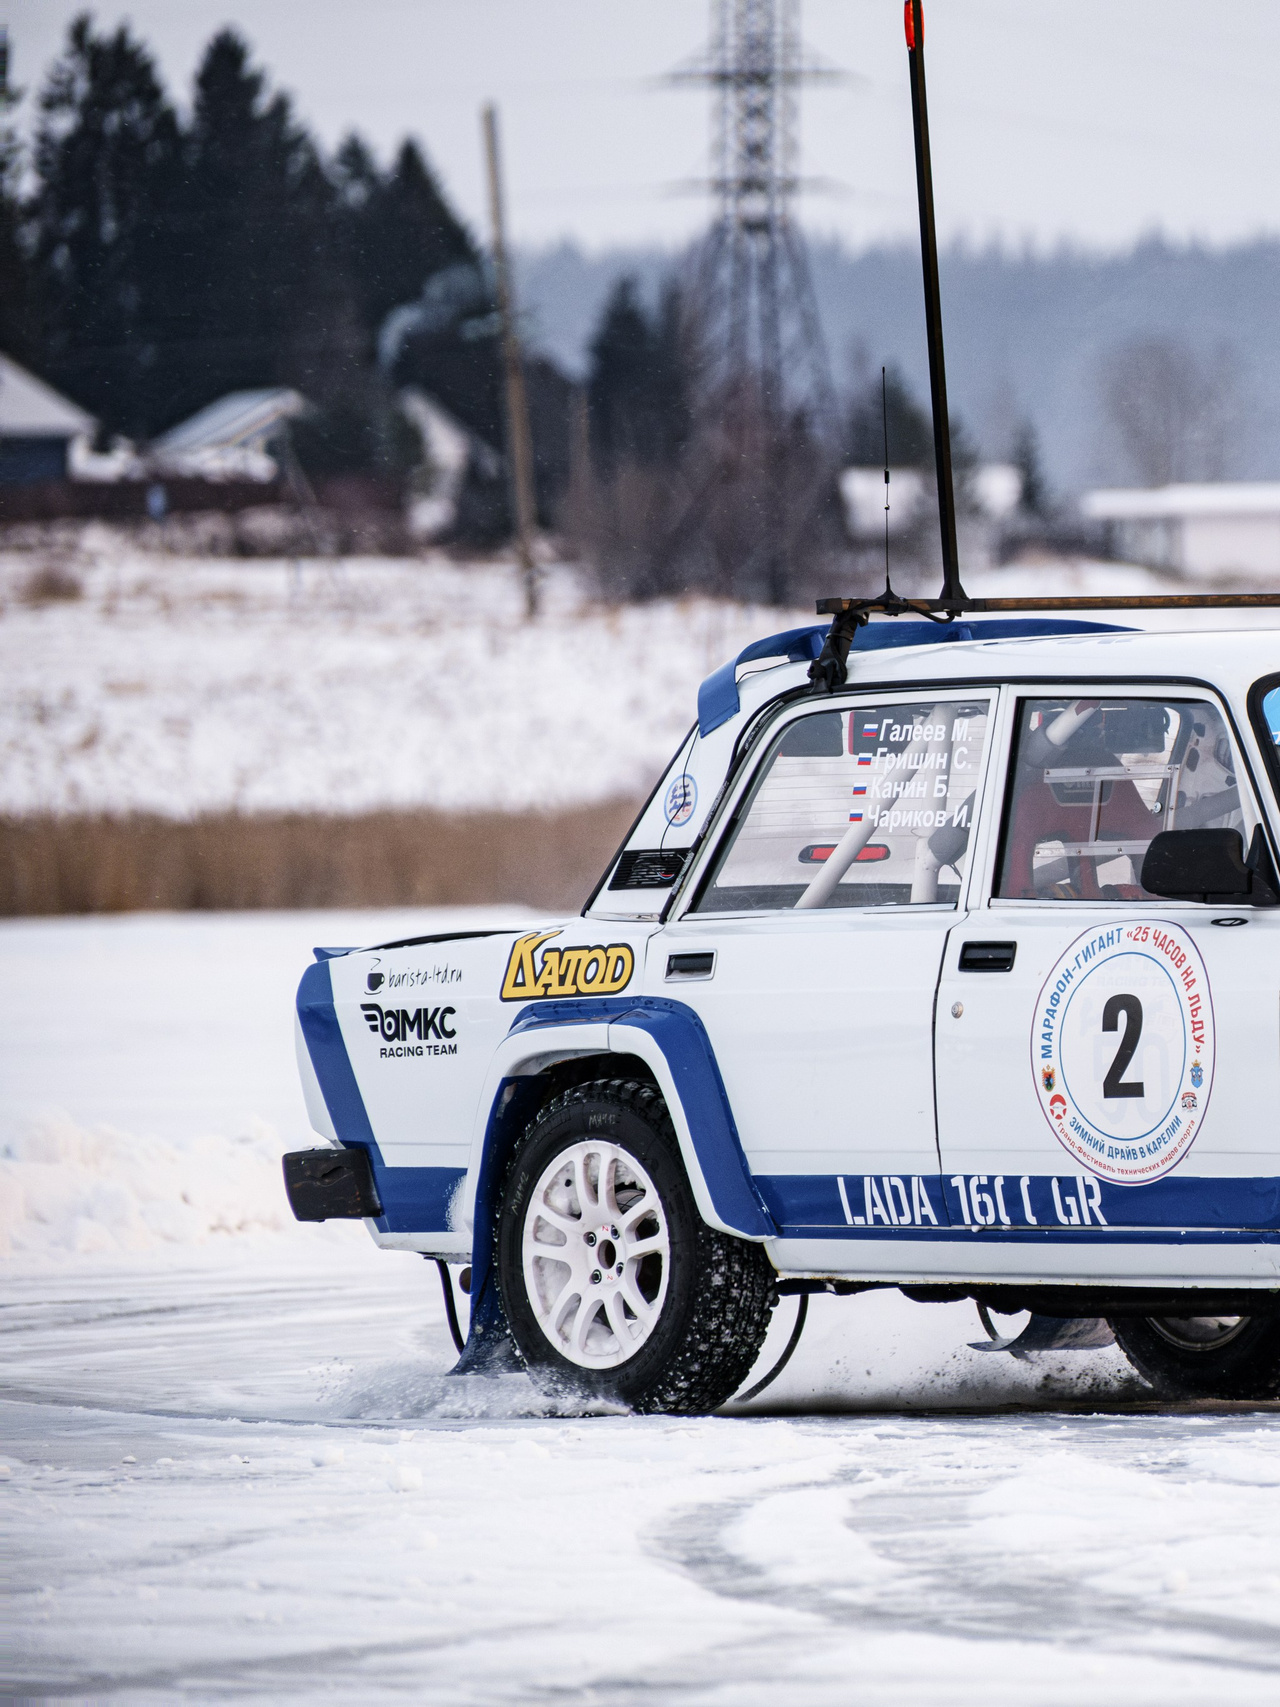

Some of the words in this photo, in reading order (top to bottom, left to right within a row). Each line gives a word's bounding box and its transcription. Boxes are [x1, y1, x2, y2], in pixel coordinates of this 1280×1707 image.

[879, 719, 946, 742] Галеев
[951, 719, 972, 742] М.
[874, 747, 948, 776] Гришин
[953, 746, 972, 769] С.
[870, 776, 927, 798] Канин
[933, 775, 951, 798] Б.
[867, 804, 947, 832] Чариков
[952, 804, 972, 828] И.
[388, 963, 463, 988] barista-ltd.ru
[1041, 927, 1124, 1059] МАРАФОН-ГИГАНТ
[1152, 928, 1187, 969] ЧАСОВ
[1180, 965, 1197, 992] НА
[380, 1046, 424, 1059] RACING
[425, 1044, 457, 1056] TEAM
[1102, 993, 1144, 1099] 2
[1069, 1116, 1106, 1155] ЗИМНИЙ
[1107, 1145, 1138, 1161] ДРАЙВ
[1139, 1147, 1146, 1159] В
[1147, 1115, 1183, 1156] КАРЕЛИИ
[836, 1176, 939, 1226] LADA
[1051, 1175, 1108, 1226] GR
